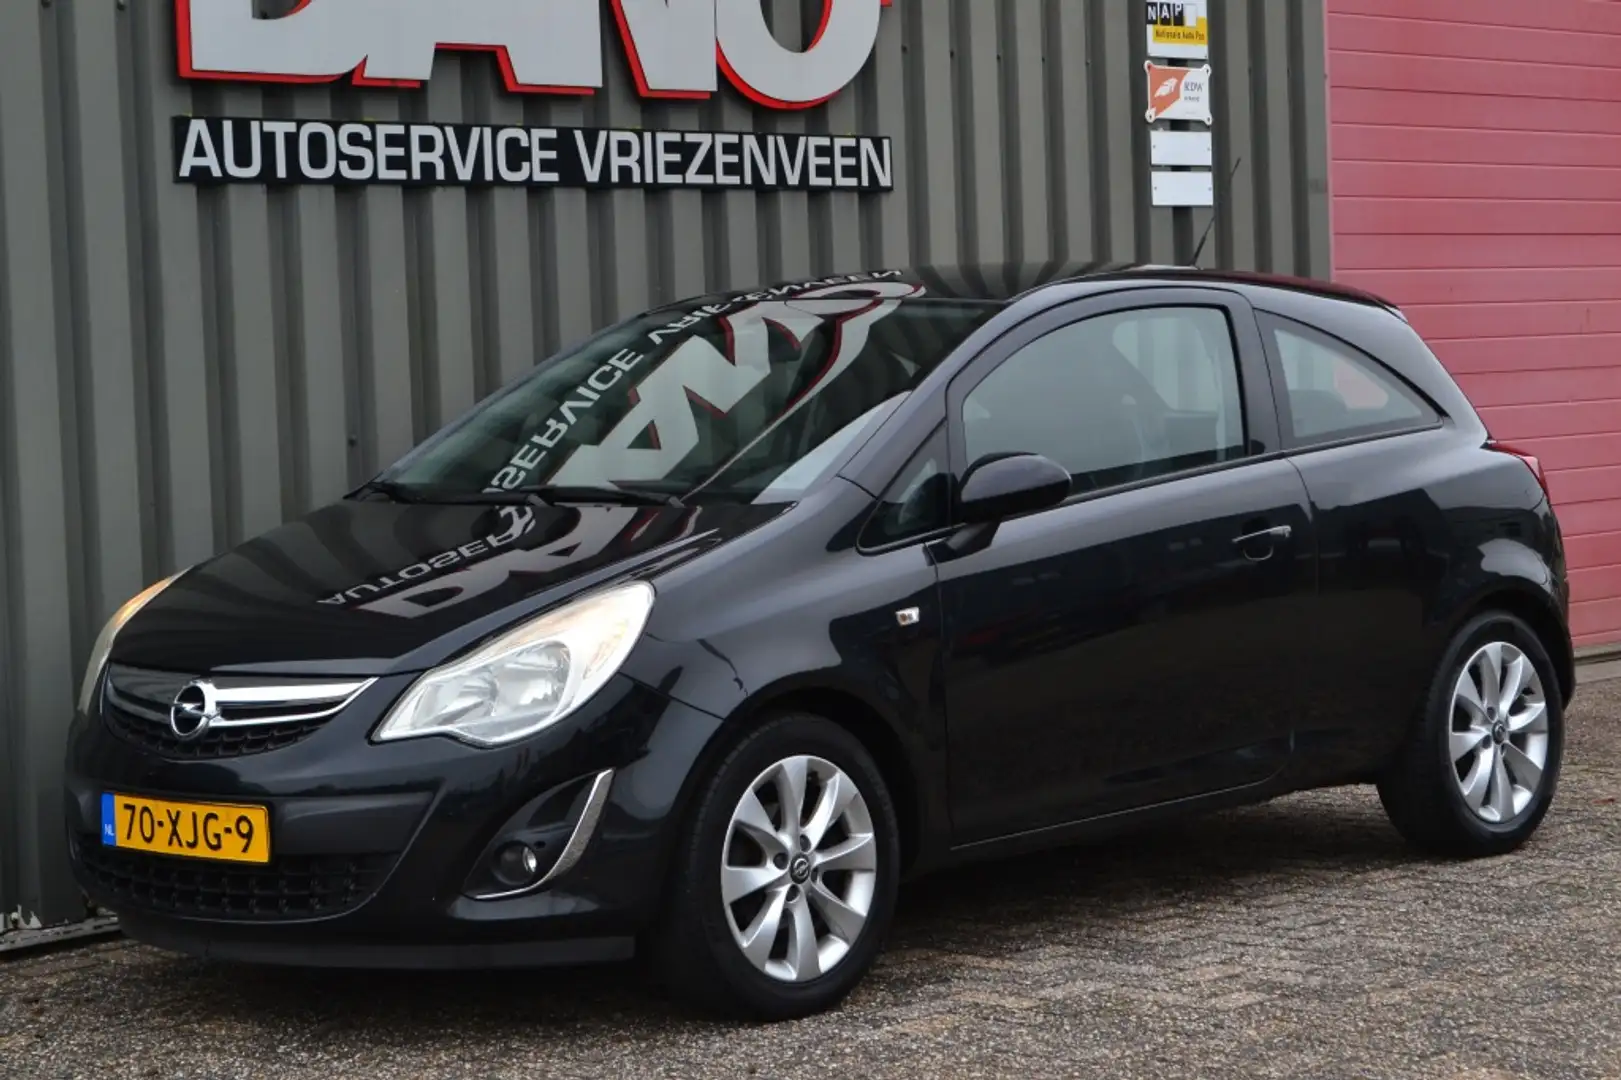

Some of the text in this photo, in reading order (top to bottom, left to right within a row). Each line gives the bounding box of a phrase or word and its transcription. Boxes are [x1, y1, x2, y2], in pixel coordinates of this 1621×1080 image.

[1148, 2, 1182, 20] NAP
[178, 119, 891, 187] AUTOSERVICE VRIEZENVEEN
[104, 803, 254, 853] NL 70-XJG-9
